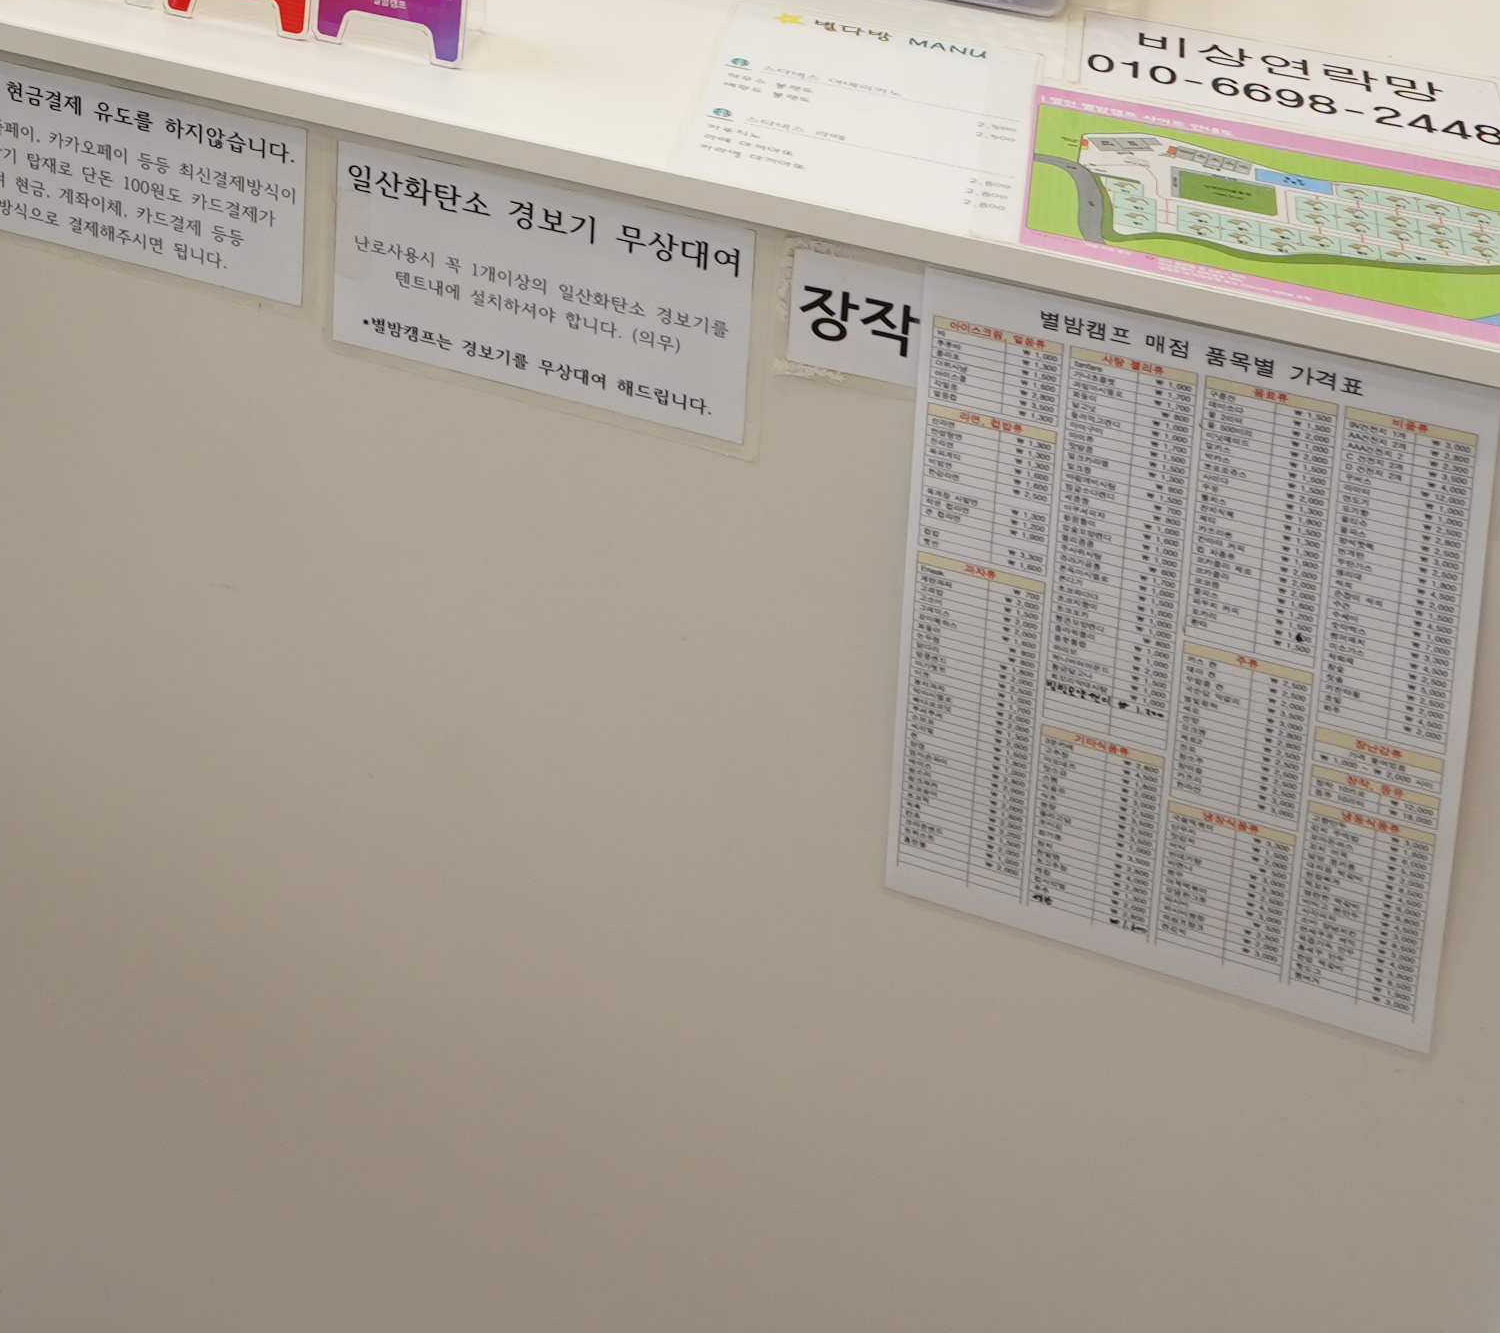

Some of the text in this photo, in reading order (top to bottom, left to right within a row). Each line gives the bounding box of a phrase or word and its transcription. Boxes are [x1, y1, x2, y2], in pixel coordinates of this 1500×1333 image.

[907, 37, 987, 60] MANU
[1136, 31, 1445, 104] 비상연락망
[7, 80, 82, 118] 현금결제
[93, 101, 153, 132] 유도를
[165, 117, 296, 165] 하지않습니다.
[347, 164, 743, 279] 일산화탄소 경보기 무상대여
[353, 234, 730, 339] 난로사용시 꼭 1개이상의 일산화탄소 경보기를
[799, 283, 922, 358] 장작
[1039, 308, 1364, 398] 별밤캠프 매점 품목별 가격표
[1253, 387, 1289, 403] 음료류
